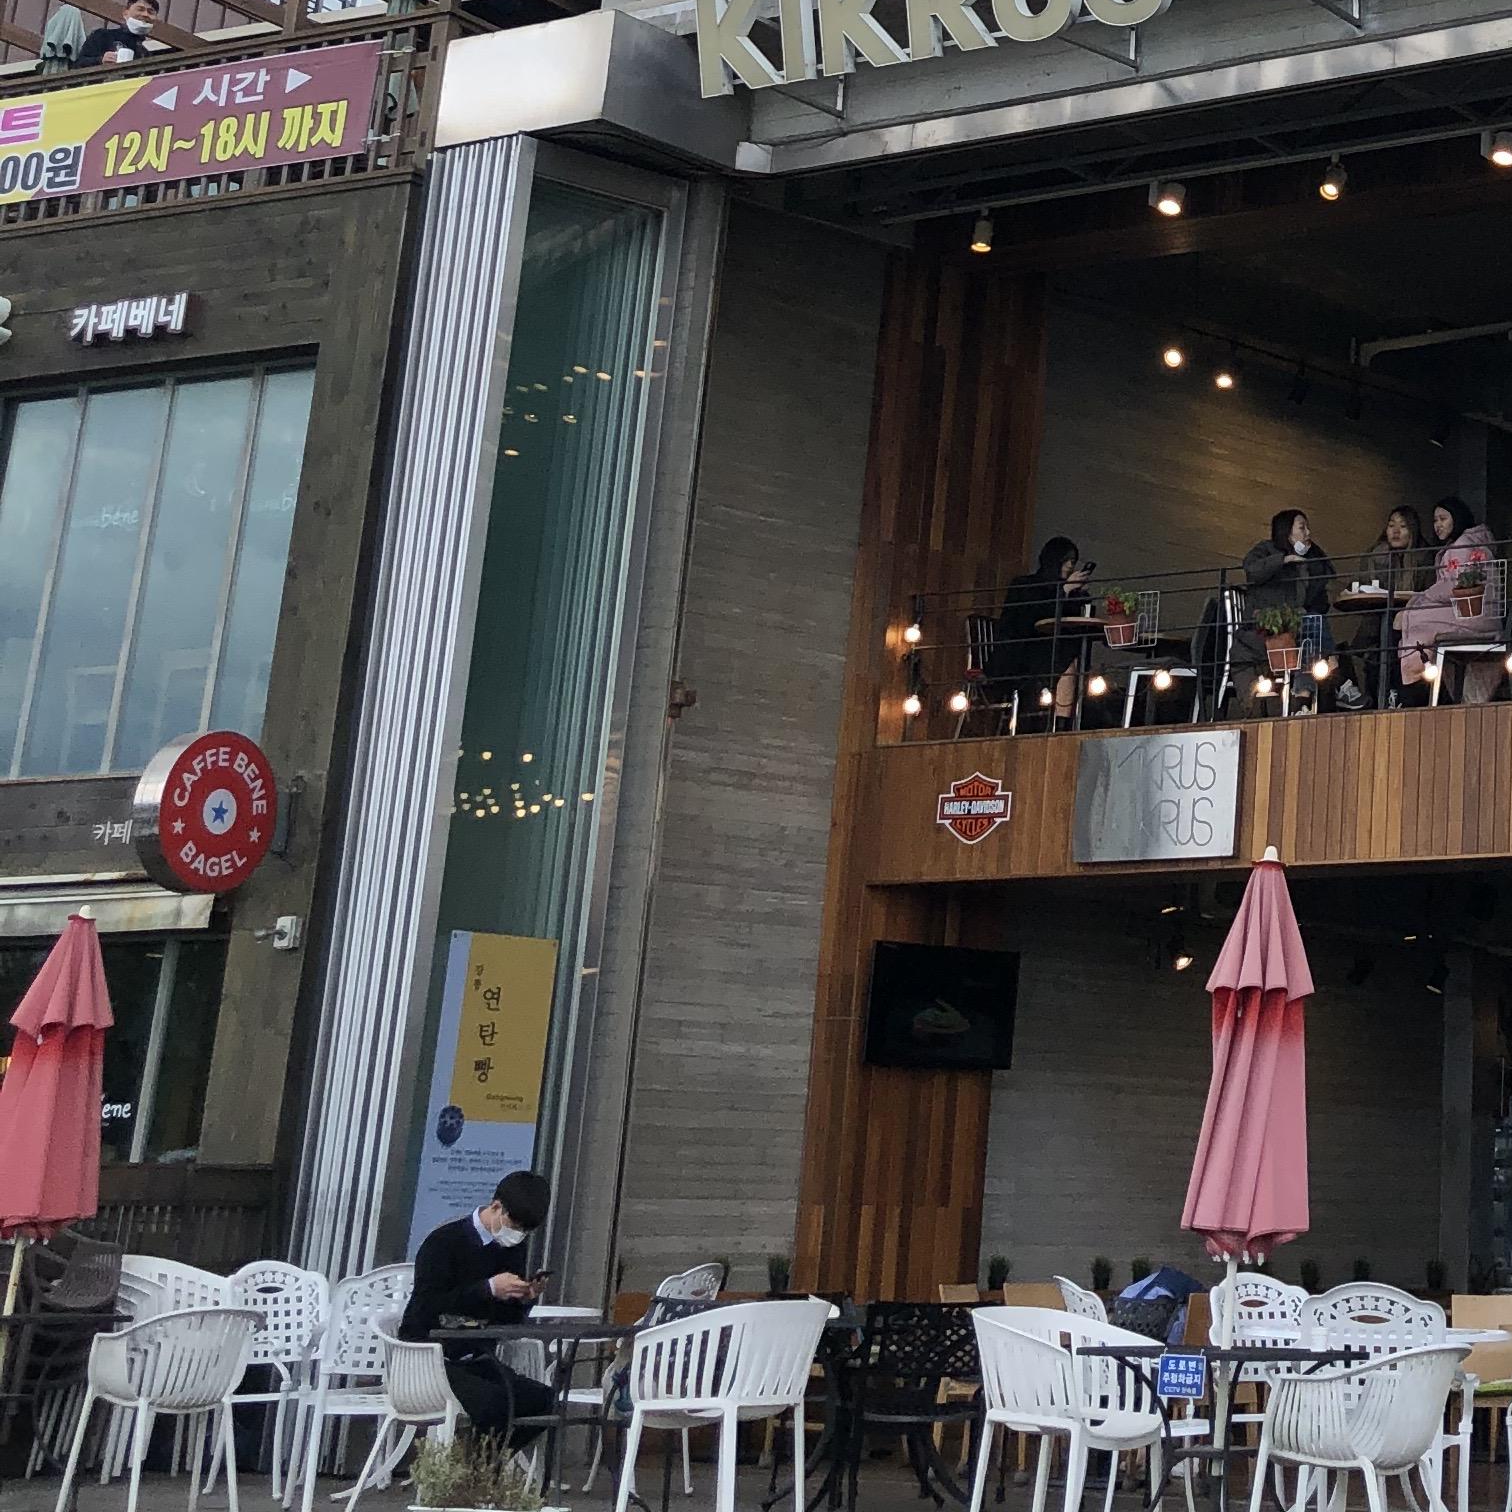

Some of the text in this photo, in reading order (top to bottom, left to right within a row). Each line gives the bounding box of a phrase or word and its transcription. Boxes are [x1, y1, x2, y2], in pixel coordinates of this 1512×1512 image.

[192, 68, 270, 107] 시간
[103, 99, 348, 178] 12시~18시 까지
[70, 291, 188, 342] 카페베네
[173, 747, 267, 815] CAFFE BENE
[959, 781, 992, 796] MOTOR
[943, 799, 1005, 815] HARLEY-DAVIDSON
[956, 818, 989, 836] CYCLES
[179, 840, 248, 877] BAGEL
[474, 986, 502, 1083] 연탄빵
[101, 1093, 132, 1119] ene
